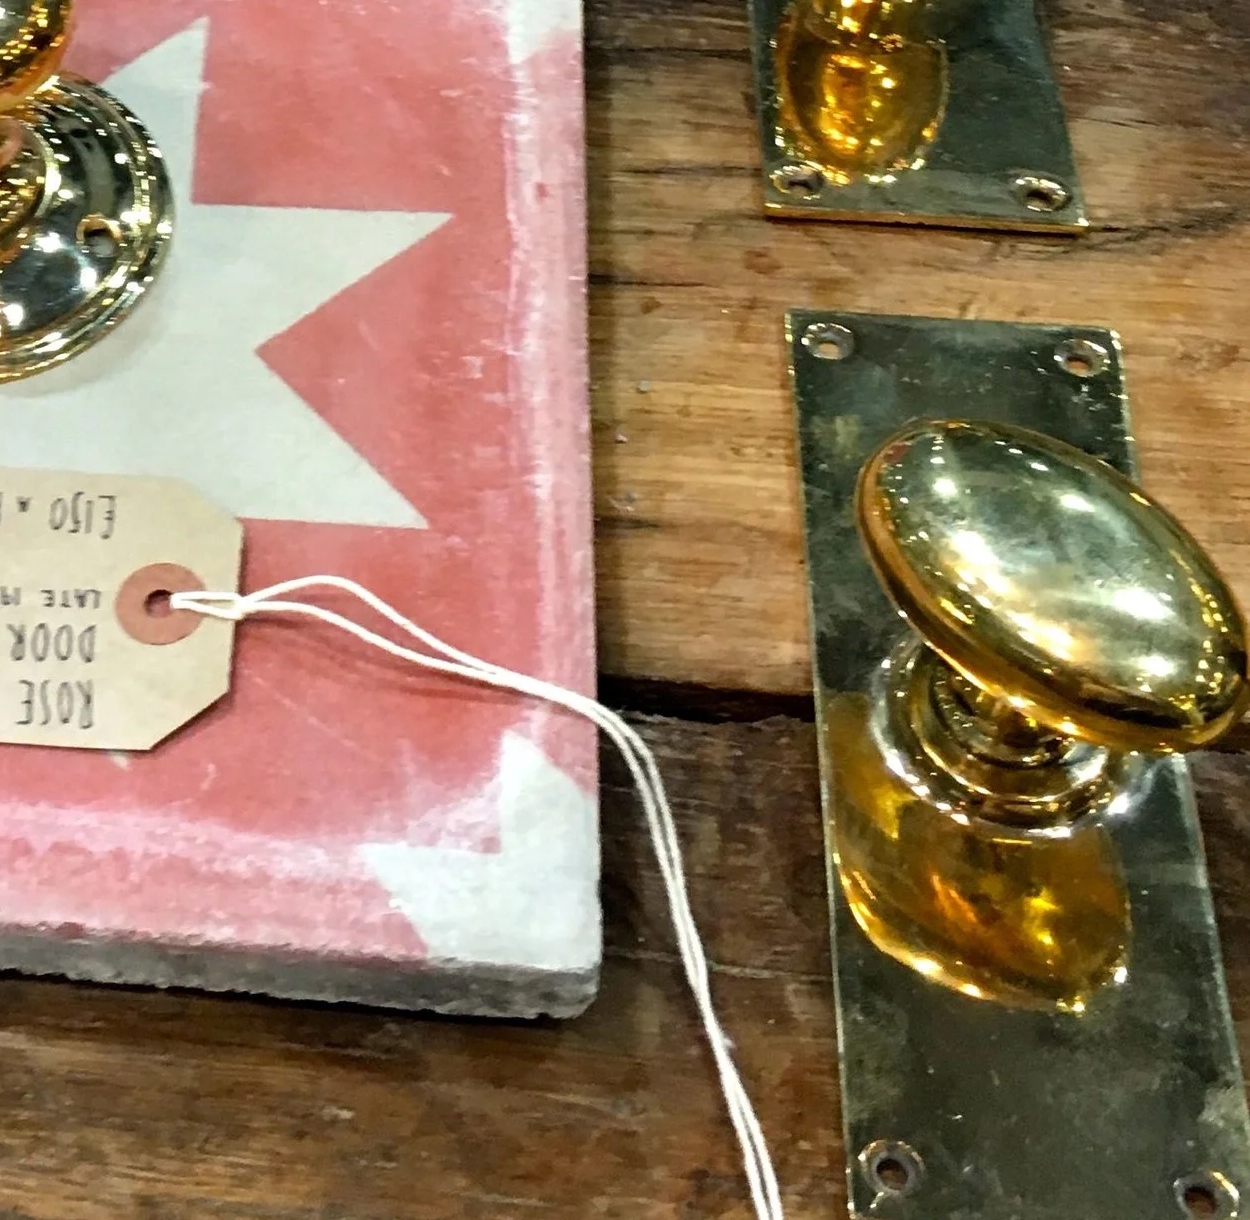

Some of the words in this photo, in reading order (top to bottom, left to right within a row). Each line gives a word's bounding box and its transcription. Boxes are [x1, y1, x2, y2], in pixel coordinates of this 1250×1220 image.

[48, 491, 117, 540] £150
[40, 589, 101, 609] LATE
[6, 623, 96, 664] DOOR
[15, 680, 95, 730] ROSE
